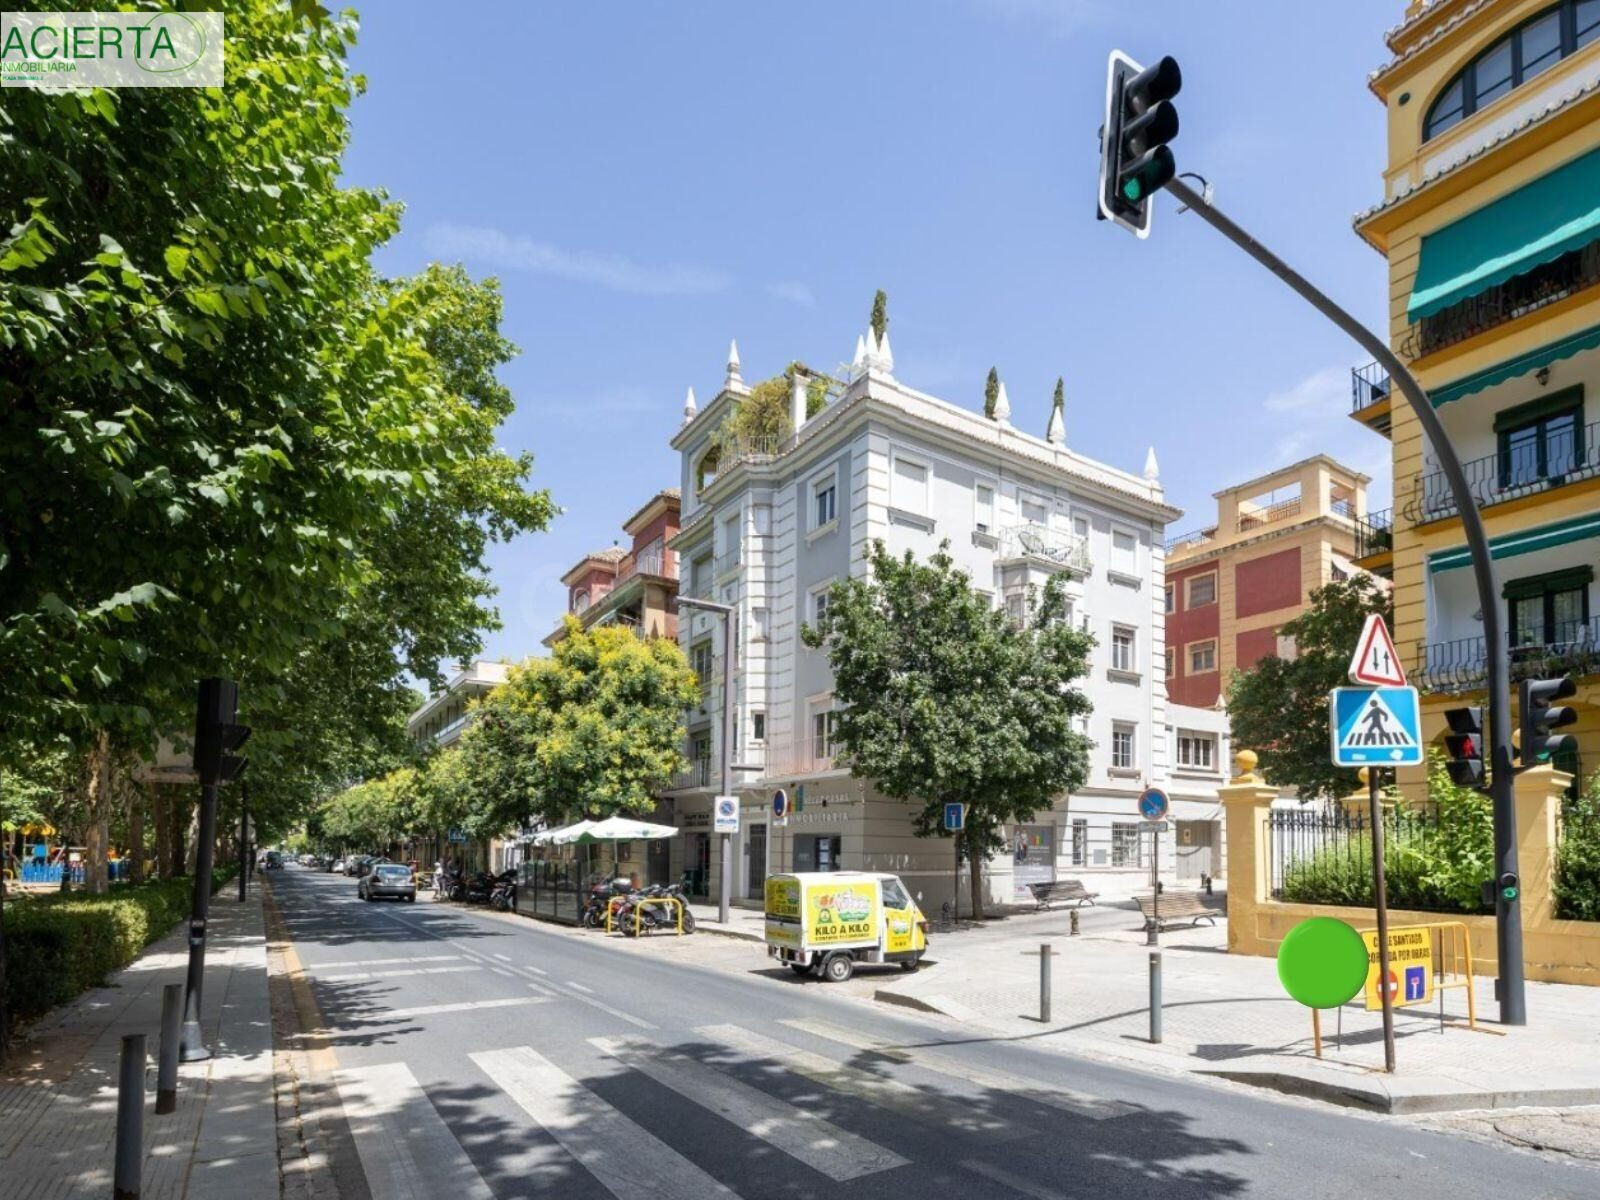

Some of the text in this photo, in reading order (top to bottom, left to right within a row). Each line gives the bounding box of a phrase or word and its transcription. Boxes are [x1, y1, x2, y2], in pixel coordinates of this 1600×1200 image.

[815, 923, 870, 936] KILO A KILO
[1393, 934, 1422, 946] SANTIAGO
